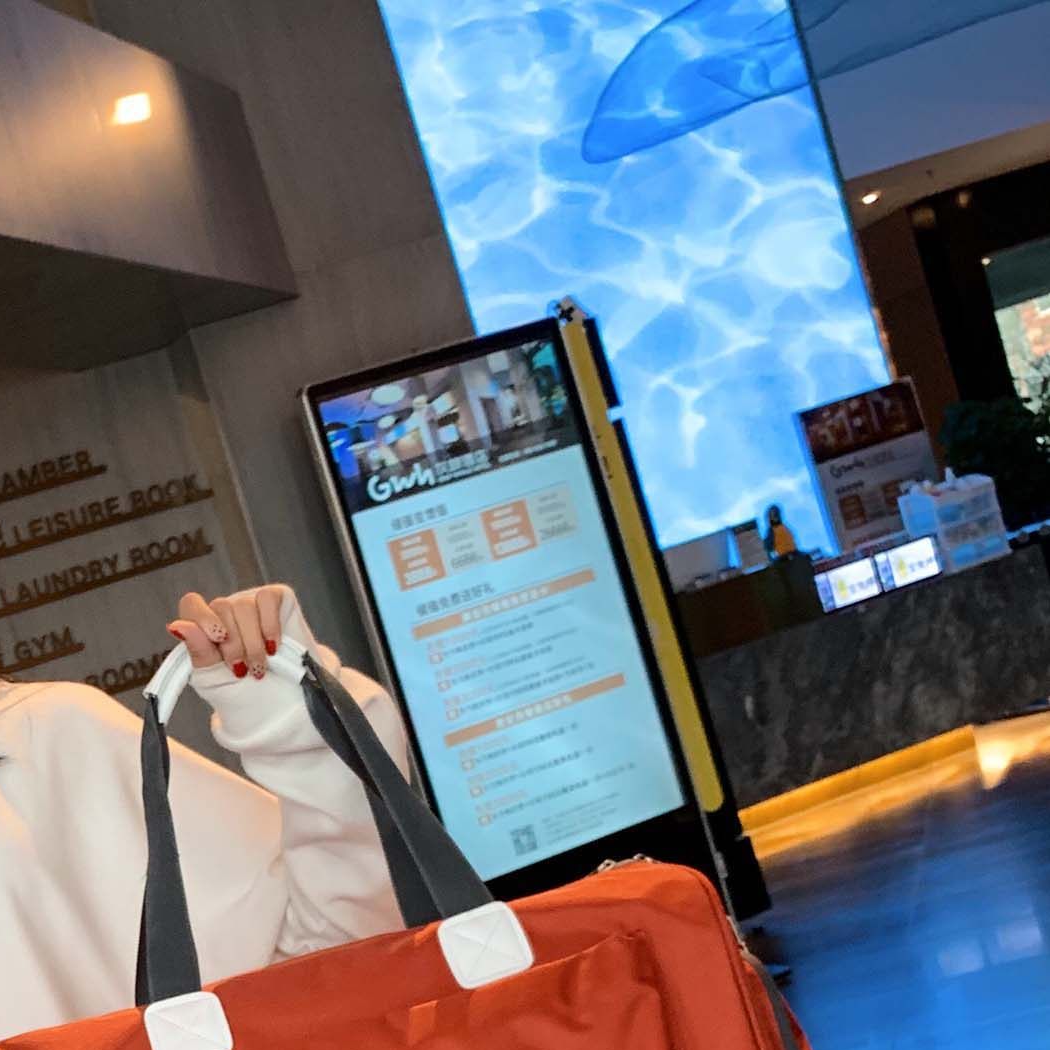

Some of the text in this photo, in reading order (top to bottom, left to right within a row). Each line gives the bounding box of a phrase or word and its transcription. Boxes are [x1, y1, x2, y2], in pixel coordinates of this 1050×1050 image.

[13, 474, 200, 544] LEISURE BOOK
[0, 527, 208, 606] LAUNDRY ROOM
[15, 625, 76, 662] GYM
